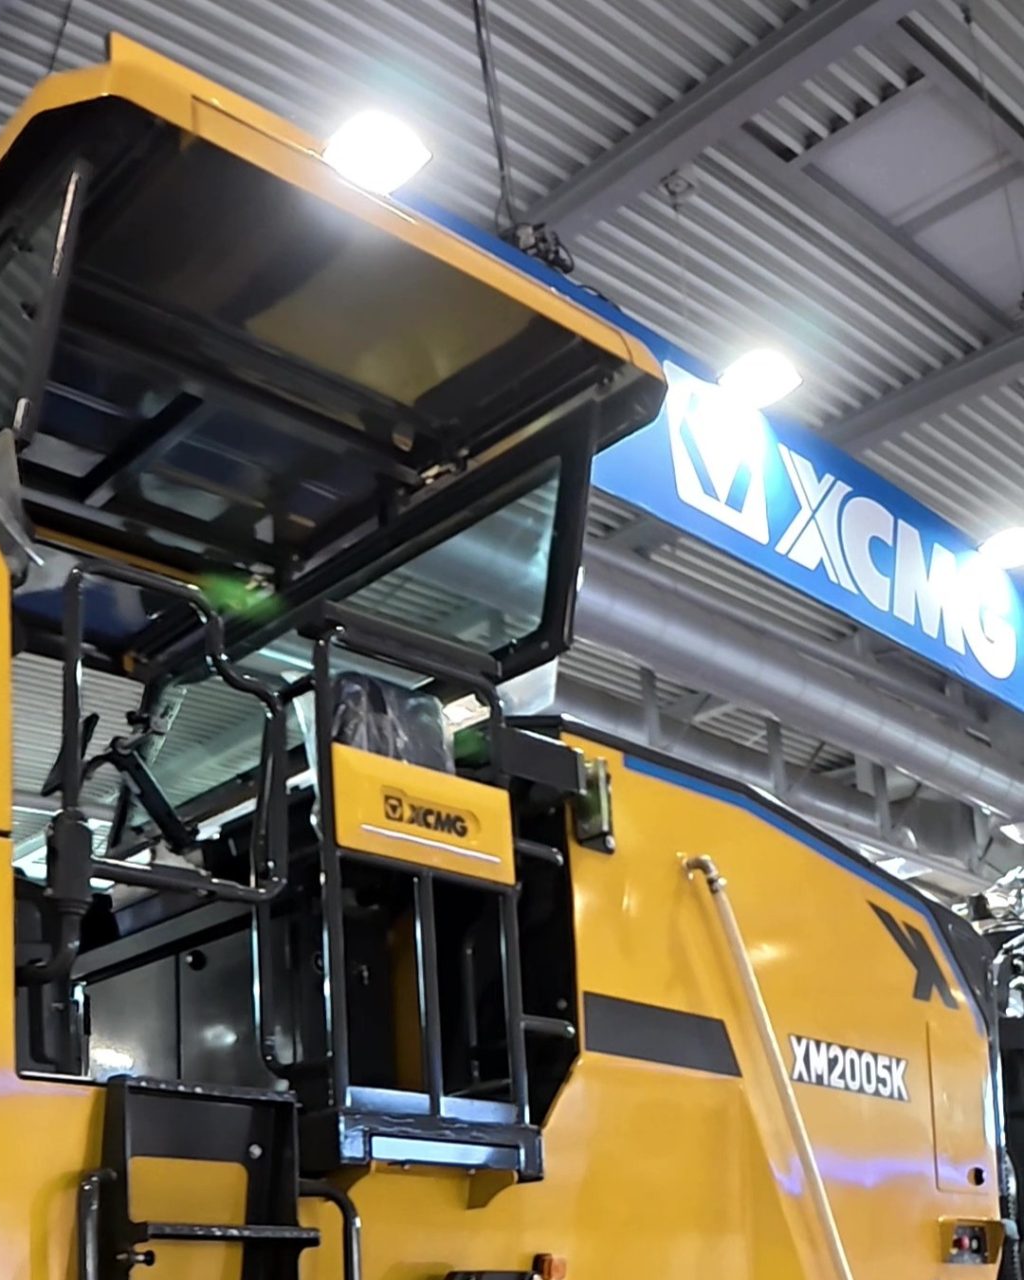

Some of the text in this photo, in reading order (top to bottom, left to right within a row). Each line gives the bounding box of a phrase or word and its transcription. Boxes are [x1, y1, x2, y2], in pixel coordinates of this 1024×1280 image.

[774, 442, 1017, 680] XCMG
[404, 803, 469, 838] XCMG
[789, 1034, 908, 1101] XM2005K
